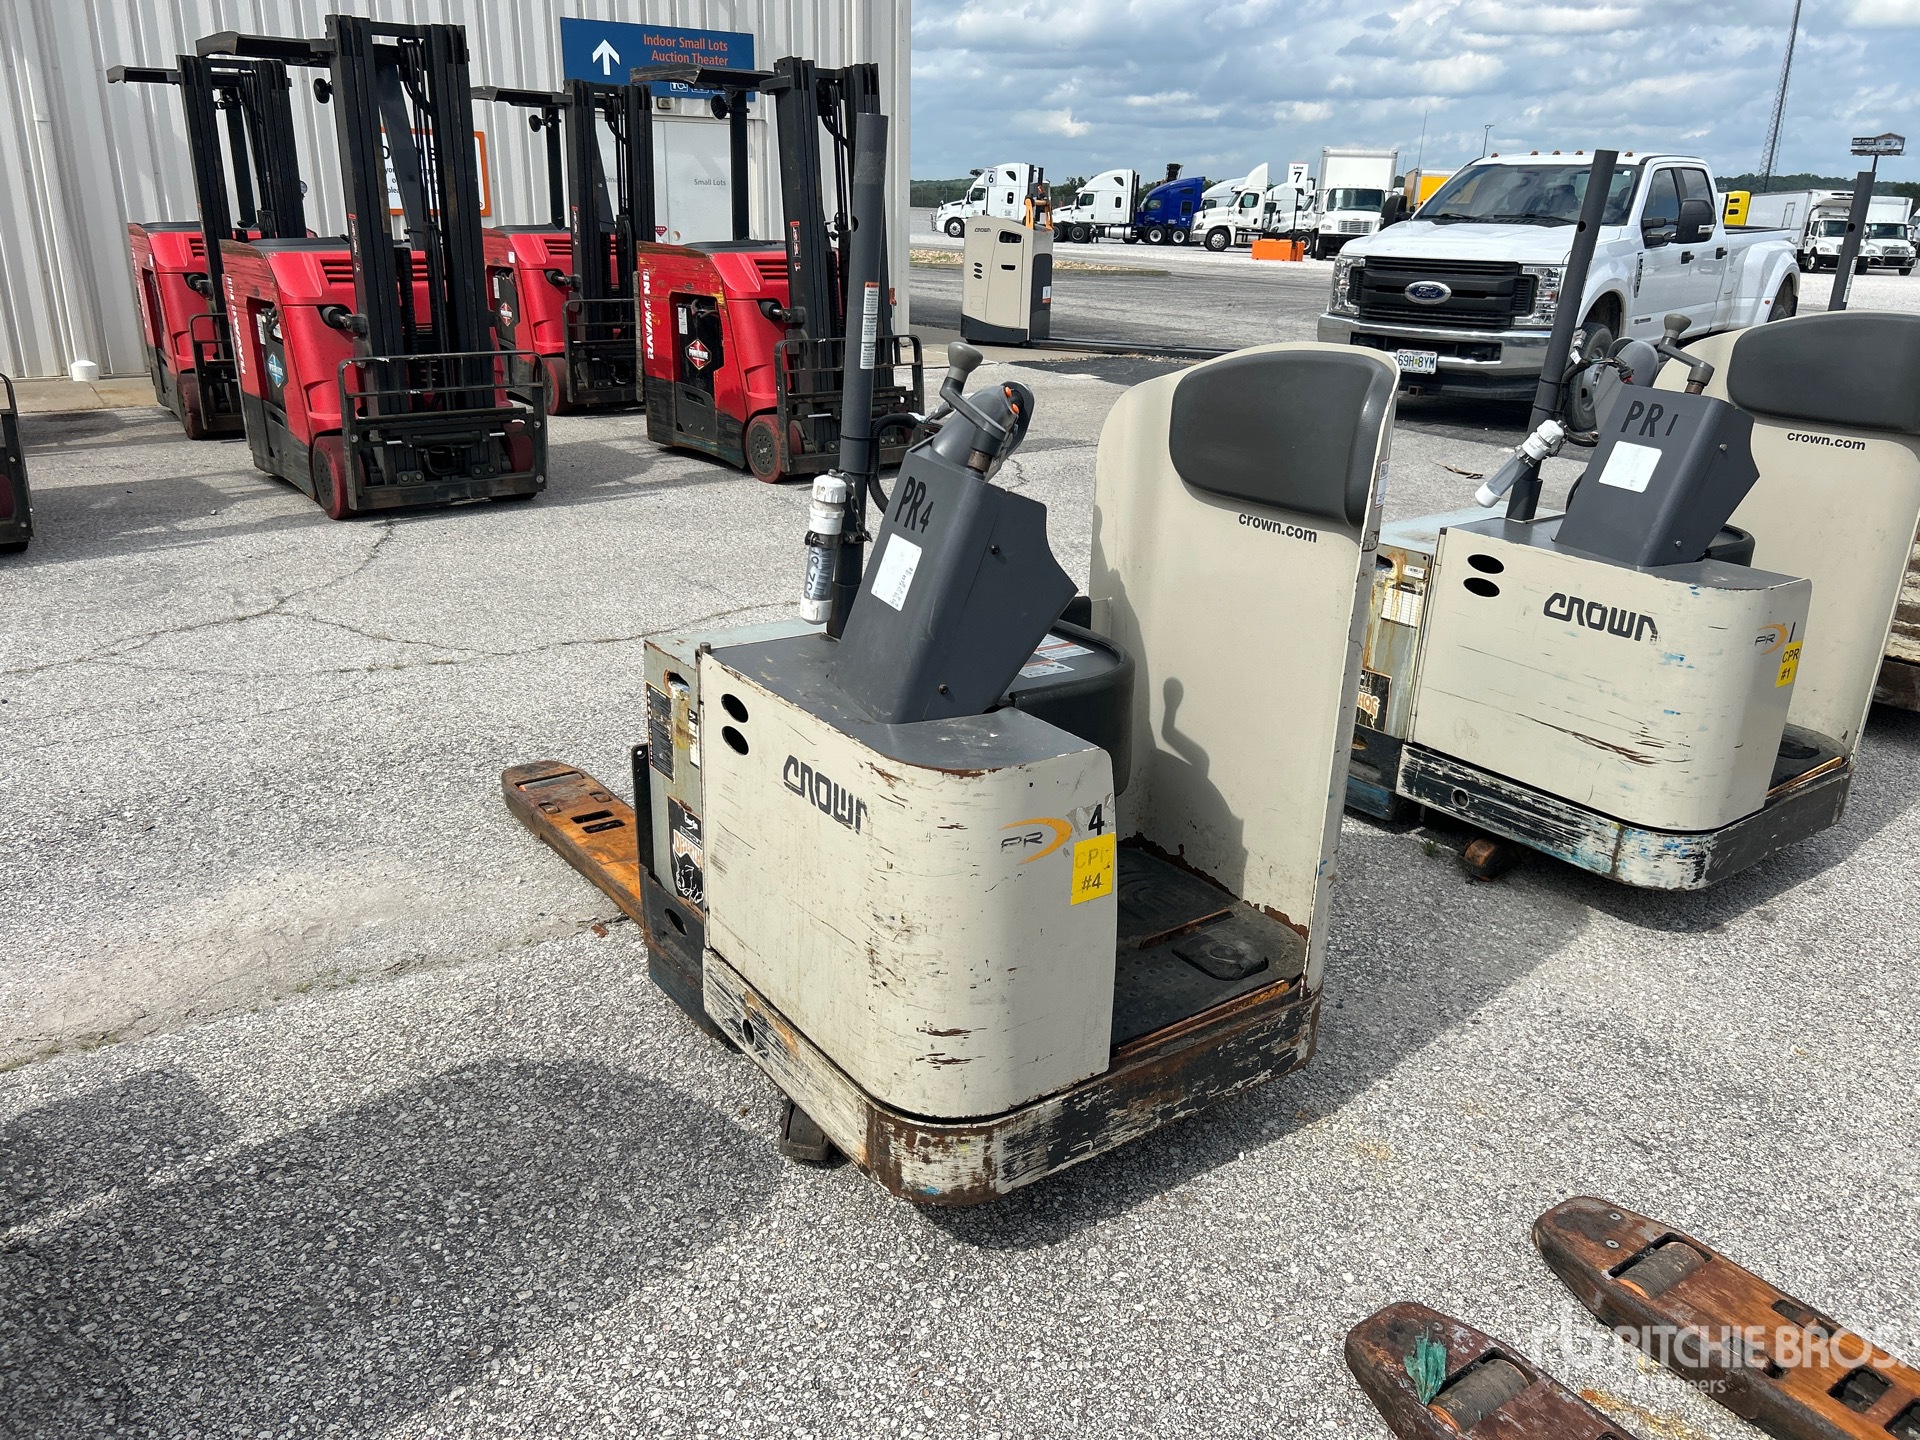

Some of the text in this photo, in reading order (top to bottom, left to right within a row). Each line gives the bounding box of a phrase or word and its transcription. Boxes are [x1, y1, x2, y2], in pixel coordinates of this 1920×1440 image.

[643, 34, 728, 51] Indoor Small Lots
[652, 50, 728, 66] Auction Theater
[694, 178, 712, 186] Small
[988, 173, 994, 183] 6
[1293, 171, 1303, 183] 7
[1415, 286, 1439, 298] Ford
[1787, 431, 1866, 451] crown.com
[1238, 513, 1318, 543] crown.com
[1782, 648, 1800, 664] CPR
[1780, 667, 1792, 681] #1
[1088, 803, 1105, 836] 4
[1082, 872, 1104, 891] #4
